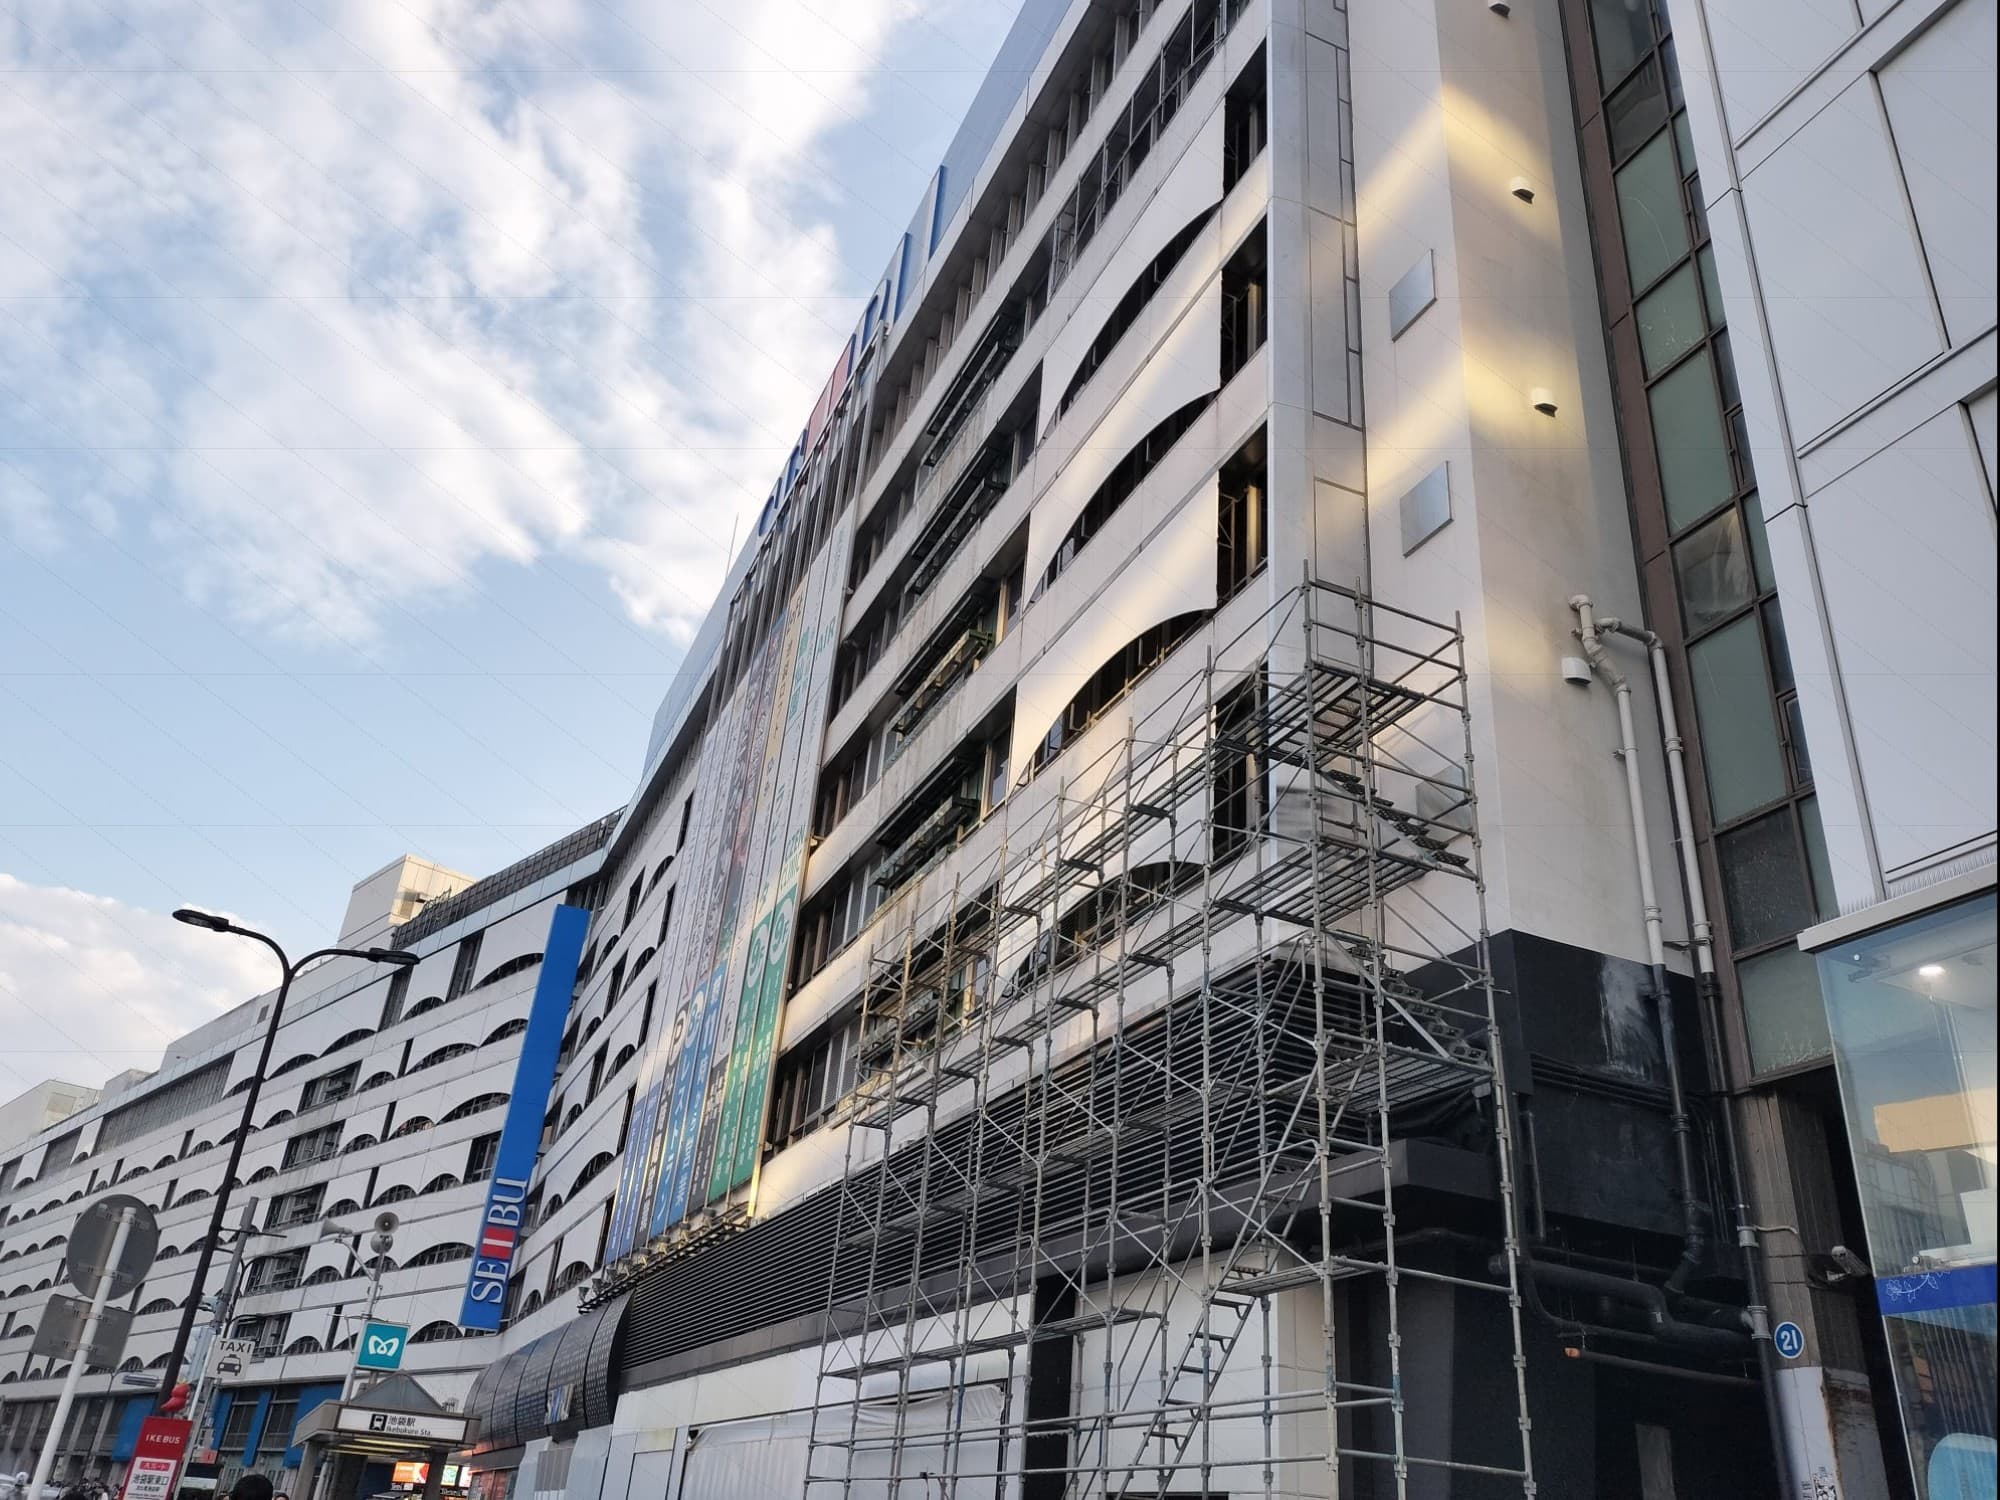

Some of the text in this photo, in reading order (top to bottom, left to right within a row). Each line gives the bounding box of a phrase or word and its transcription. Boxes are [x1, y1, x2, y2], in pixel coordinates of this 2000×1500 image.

[654, 1045, 693, 1223] レストラン
[470, 1177, 528, 1304] SEIBU
[219, 1340, 251, 1354] TAXI
[1781, 1329, 1798, 1350] 21
[388, 1415, 416, 1427] 池袋駅
[386, 1425, 419, 1435] Ikebukuro
